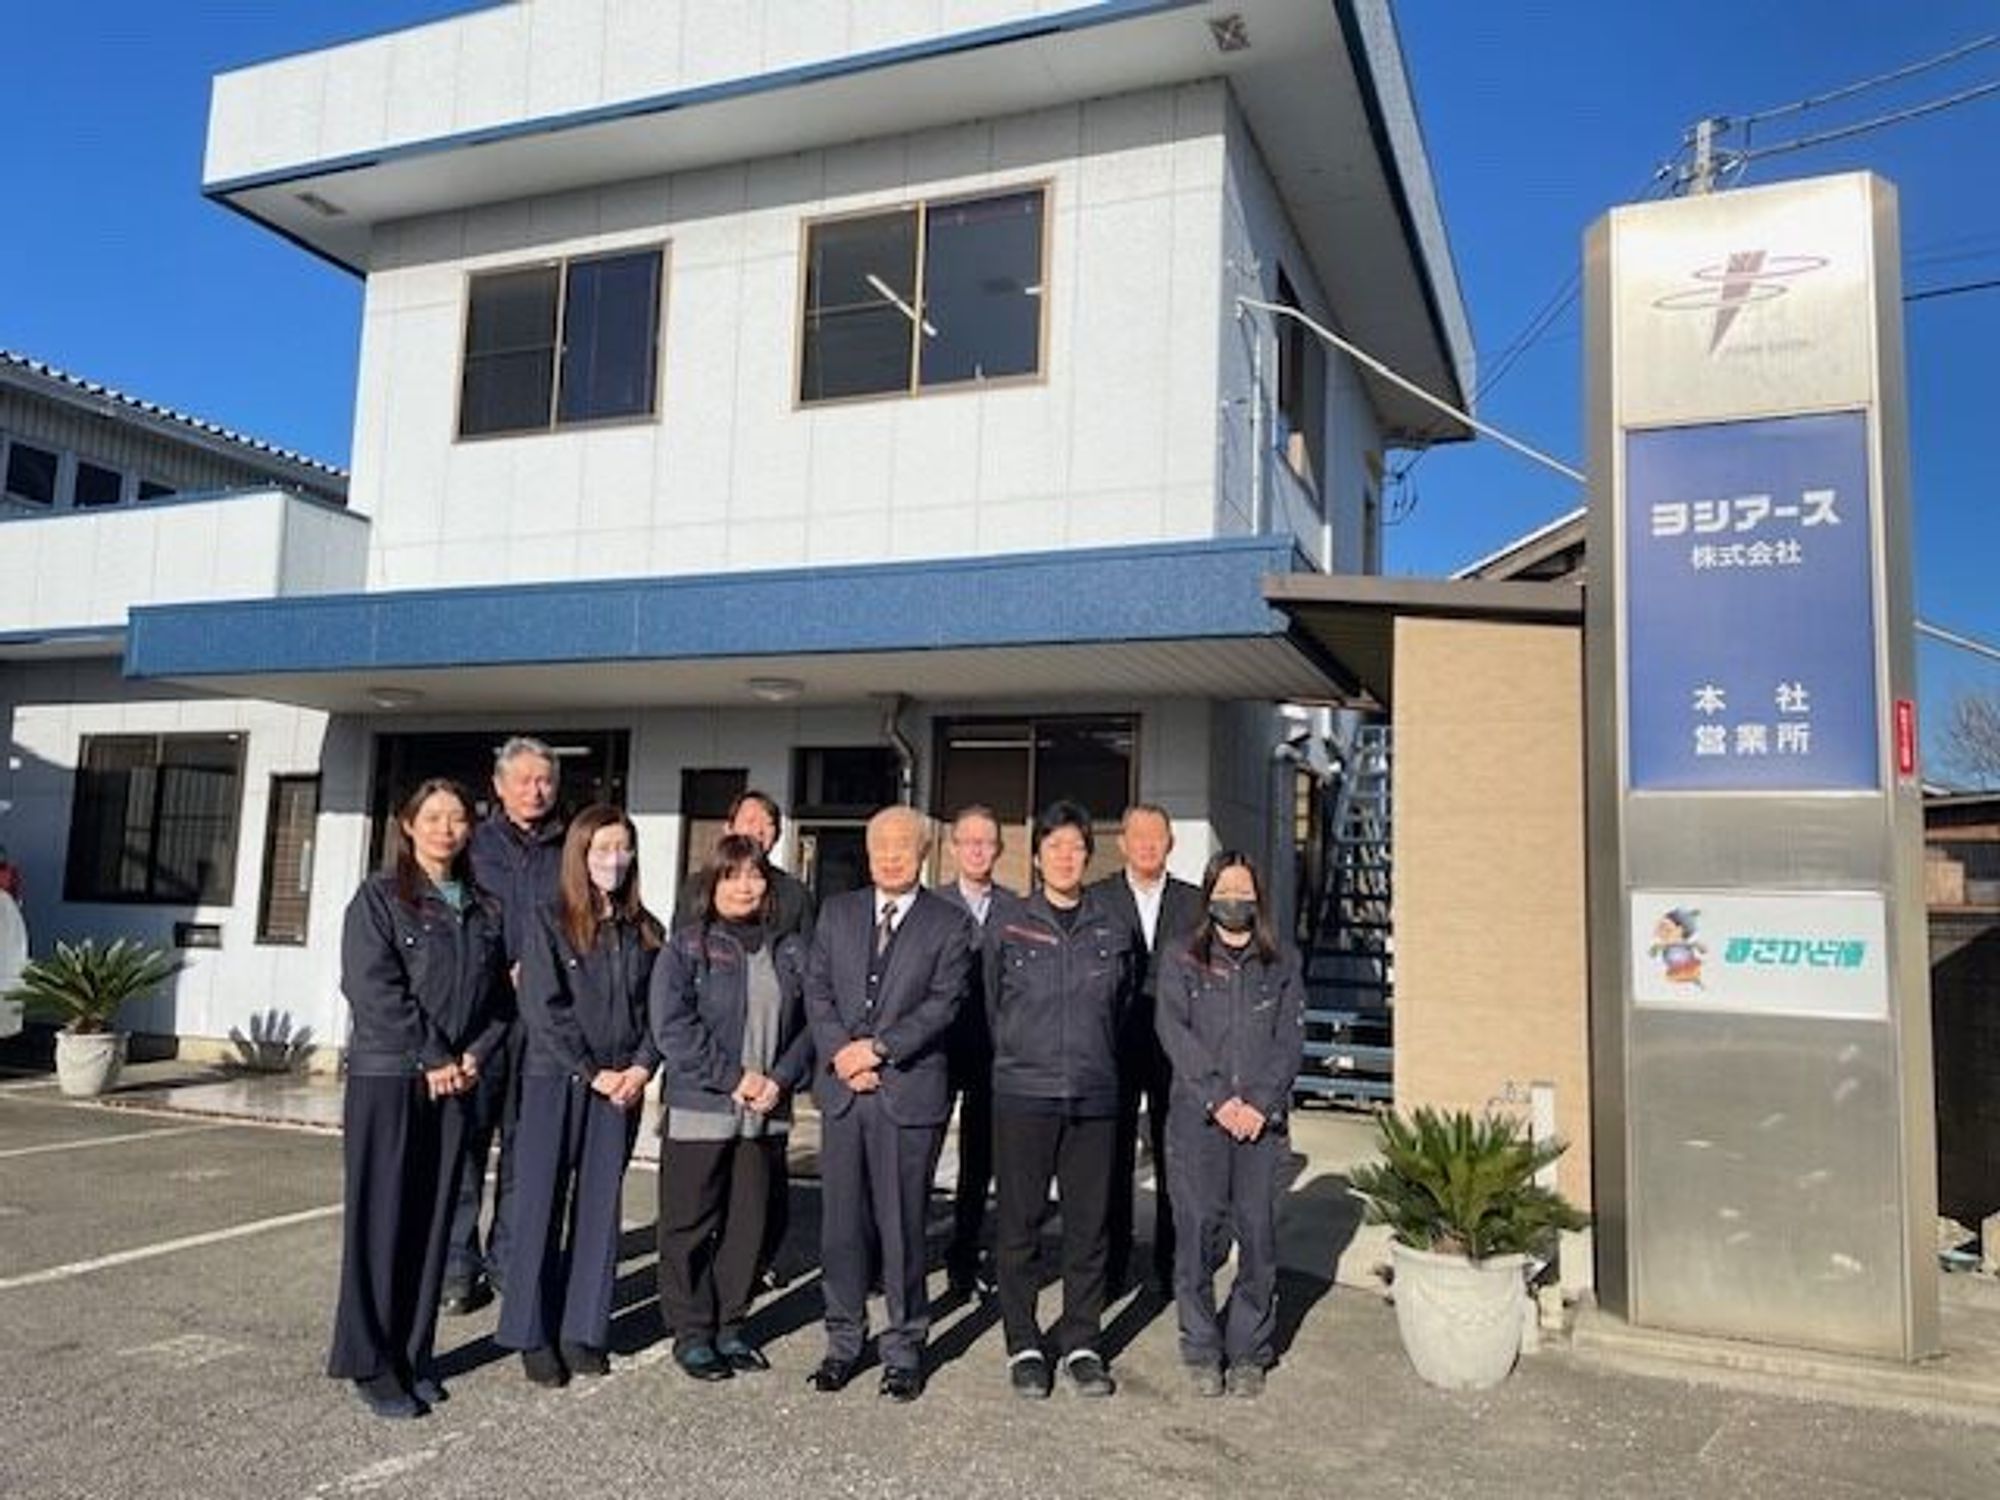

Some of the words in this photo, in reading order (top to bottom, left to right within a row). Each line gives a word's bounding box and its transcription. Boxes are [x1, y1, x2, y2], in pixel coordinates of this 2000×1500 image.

[1652, 490, 1840, 536] ヨシアース
[1692, 538, 1802, 570] 株式会社
[1695, 721, 1810, 754] 営業所
